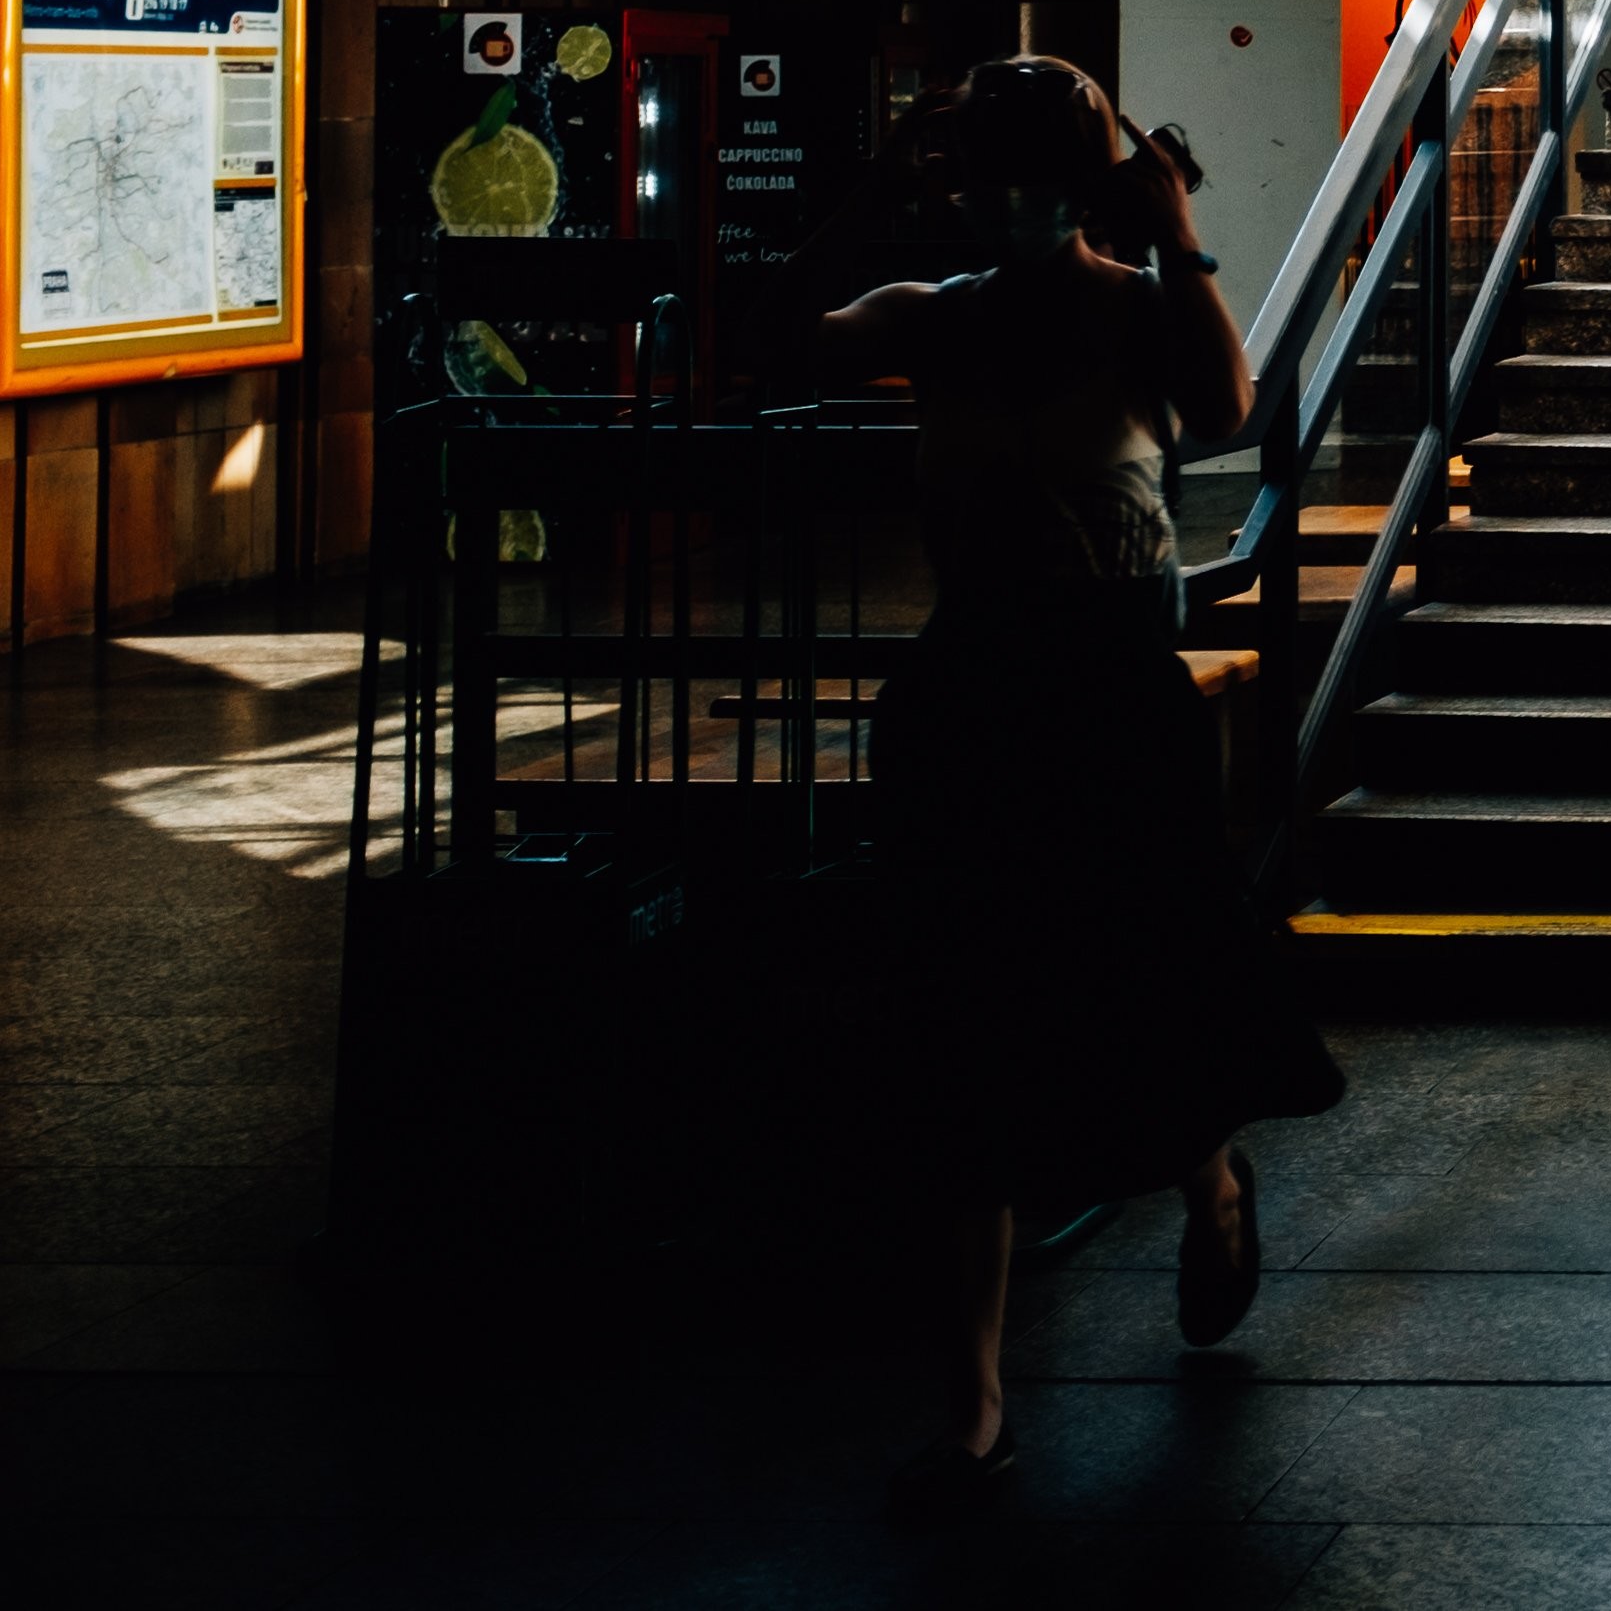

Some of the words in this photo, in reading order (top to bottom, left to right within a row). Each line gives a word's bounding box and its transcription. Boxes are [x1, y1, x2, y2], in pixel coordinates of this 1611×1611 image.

[718, 148, 804, 164] CAPPUCCINO
[726, 175, 796, 191] ČOKOLÁDA
[724, 250, 755, 264] we
[760, 246, 799, 263] lov
